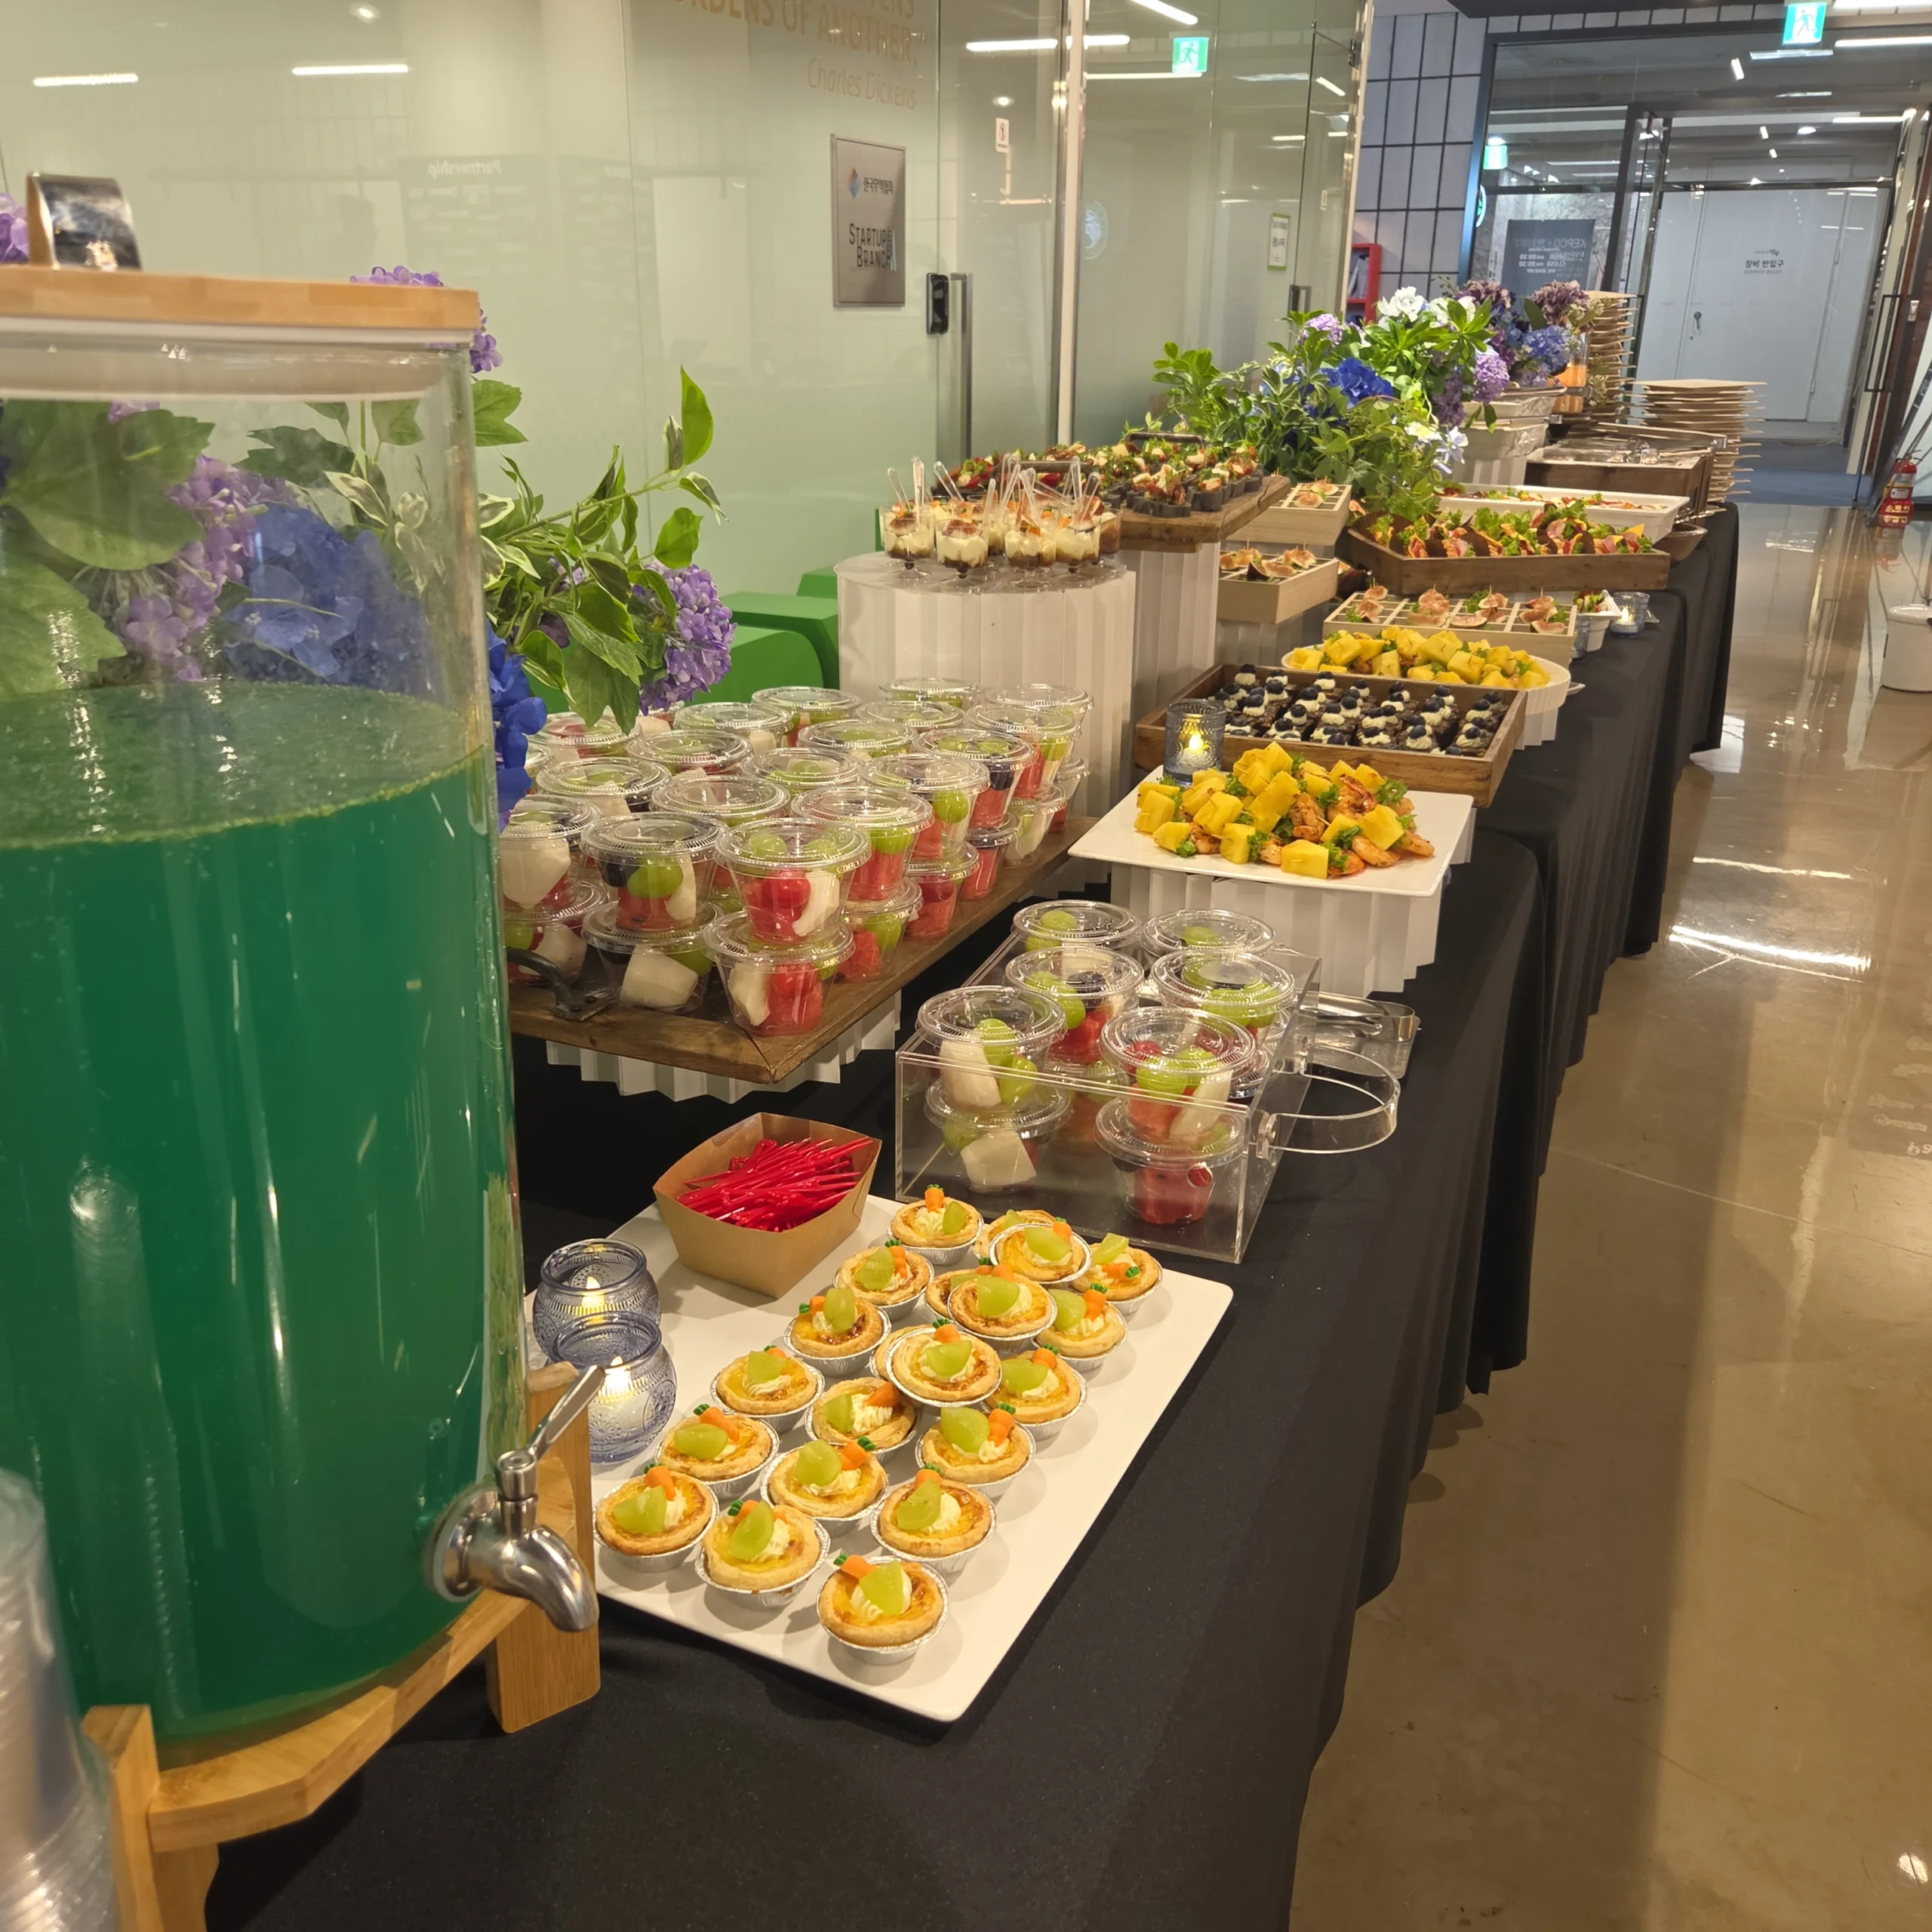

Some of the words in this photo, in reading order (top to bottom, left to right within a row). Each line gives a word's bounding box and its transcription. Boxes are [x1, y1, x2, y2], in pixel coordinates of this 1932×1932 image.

[783, 0, 811, 35] OF
[808, 58, 861, 98] Charles
[866, 72, 916, 109] Dickens
